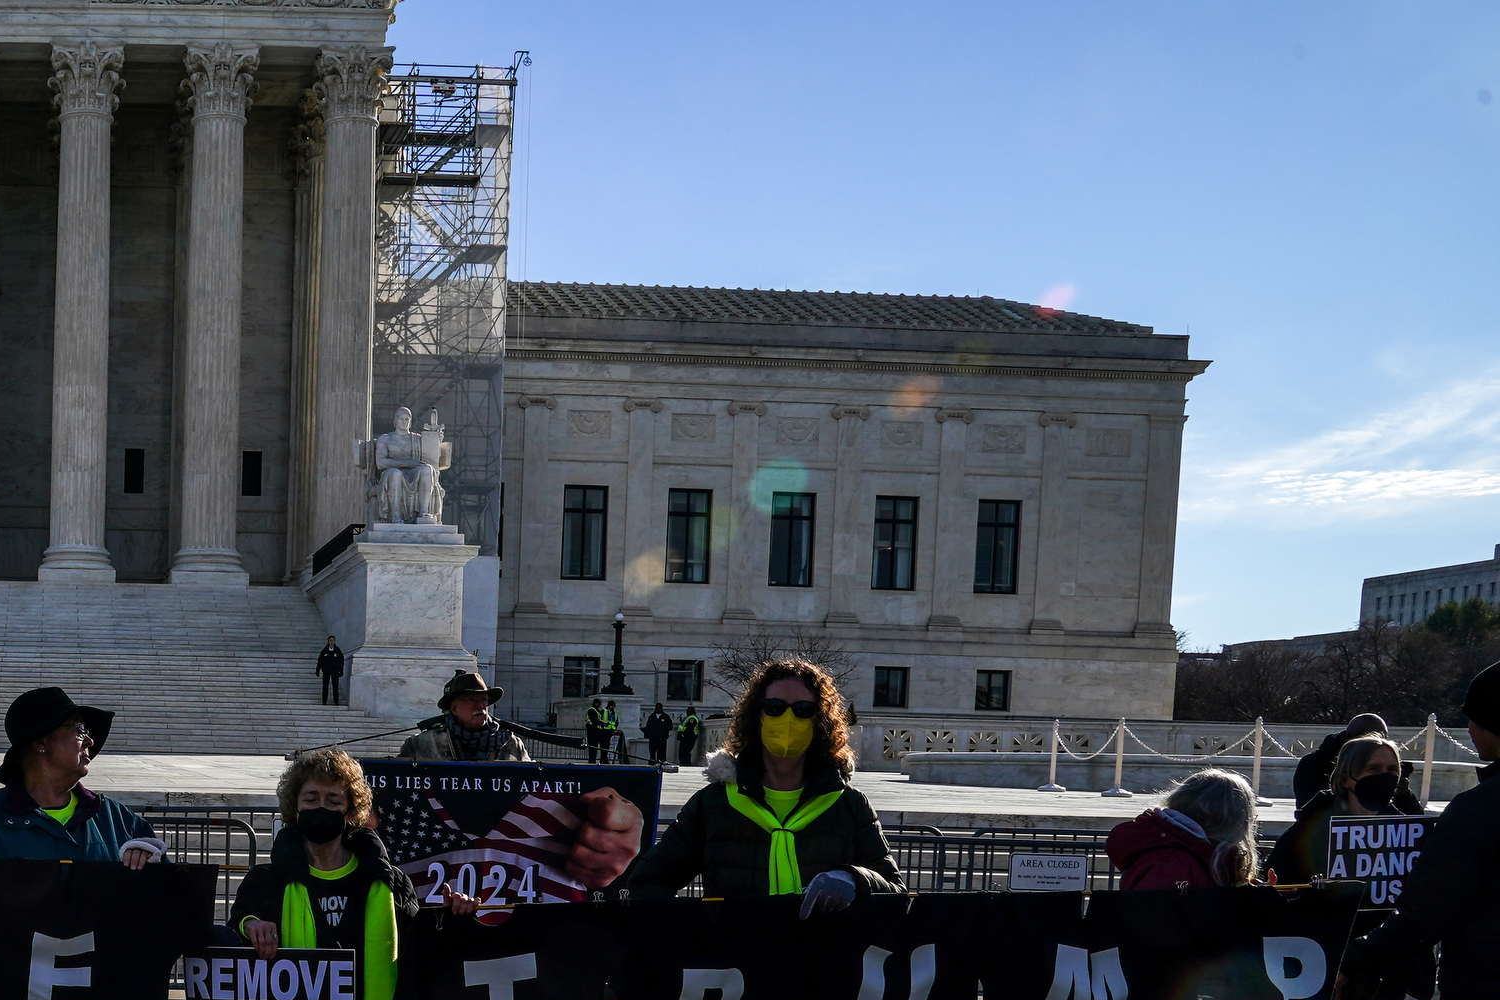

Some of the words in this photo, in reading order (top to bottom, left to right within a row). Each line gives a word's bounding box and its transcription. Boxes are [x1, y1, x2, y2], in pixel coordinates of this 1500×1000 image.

[395, 776, 431, 790] LIES
[440, 777, 483, 790] TEAR
[492, 778, 511, 792] US
[520, 780, 581, 794] APART!
[1332, 823, 1424, 850] TRUMP
[1020, 860, 1043, 868] AREA
[1047, 860, 1080, 869] CLOSED
[1330, 854, 1347, 878] A
[425, 862, 536, 906] 2024
